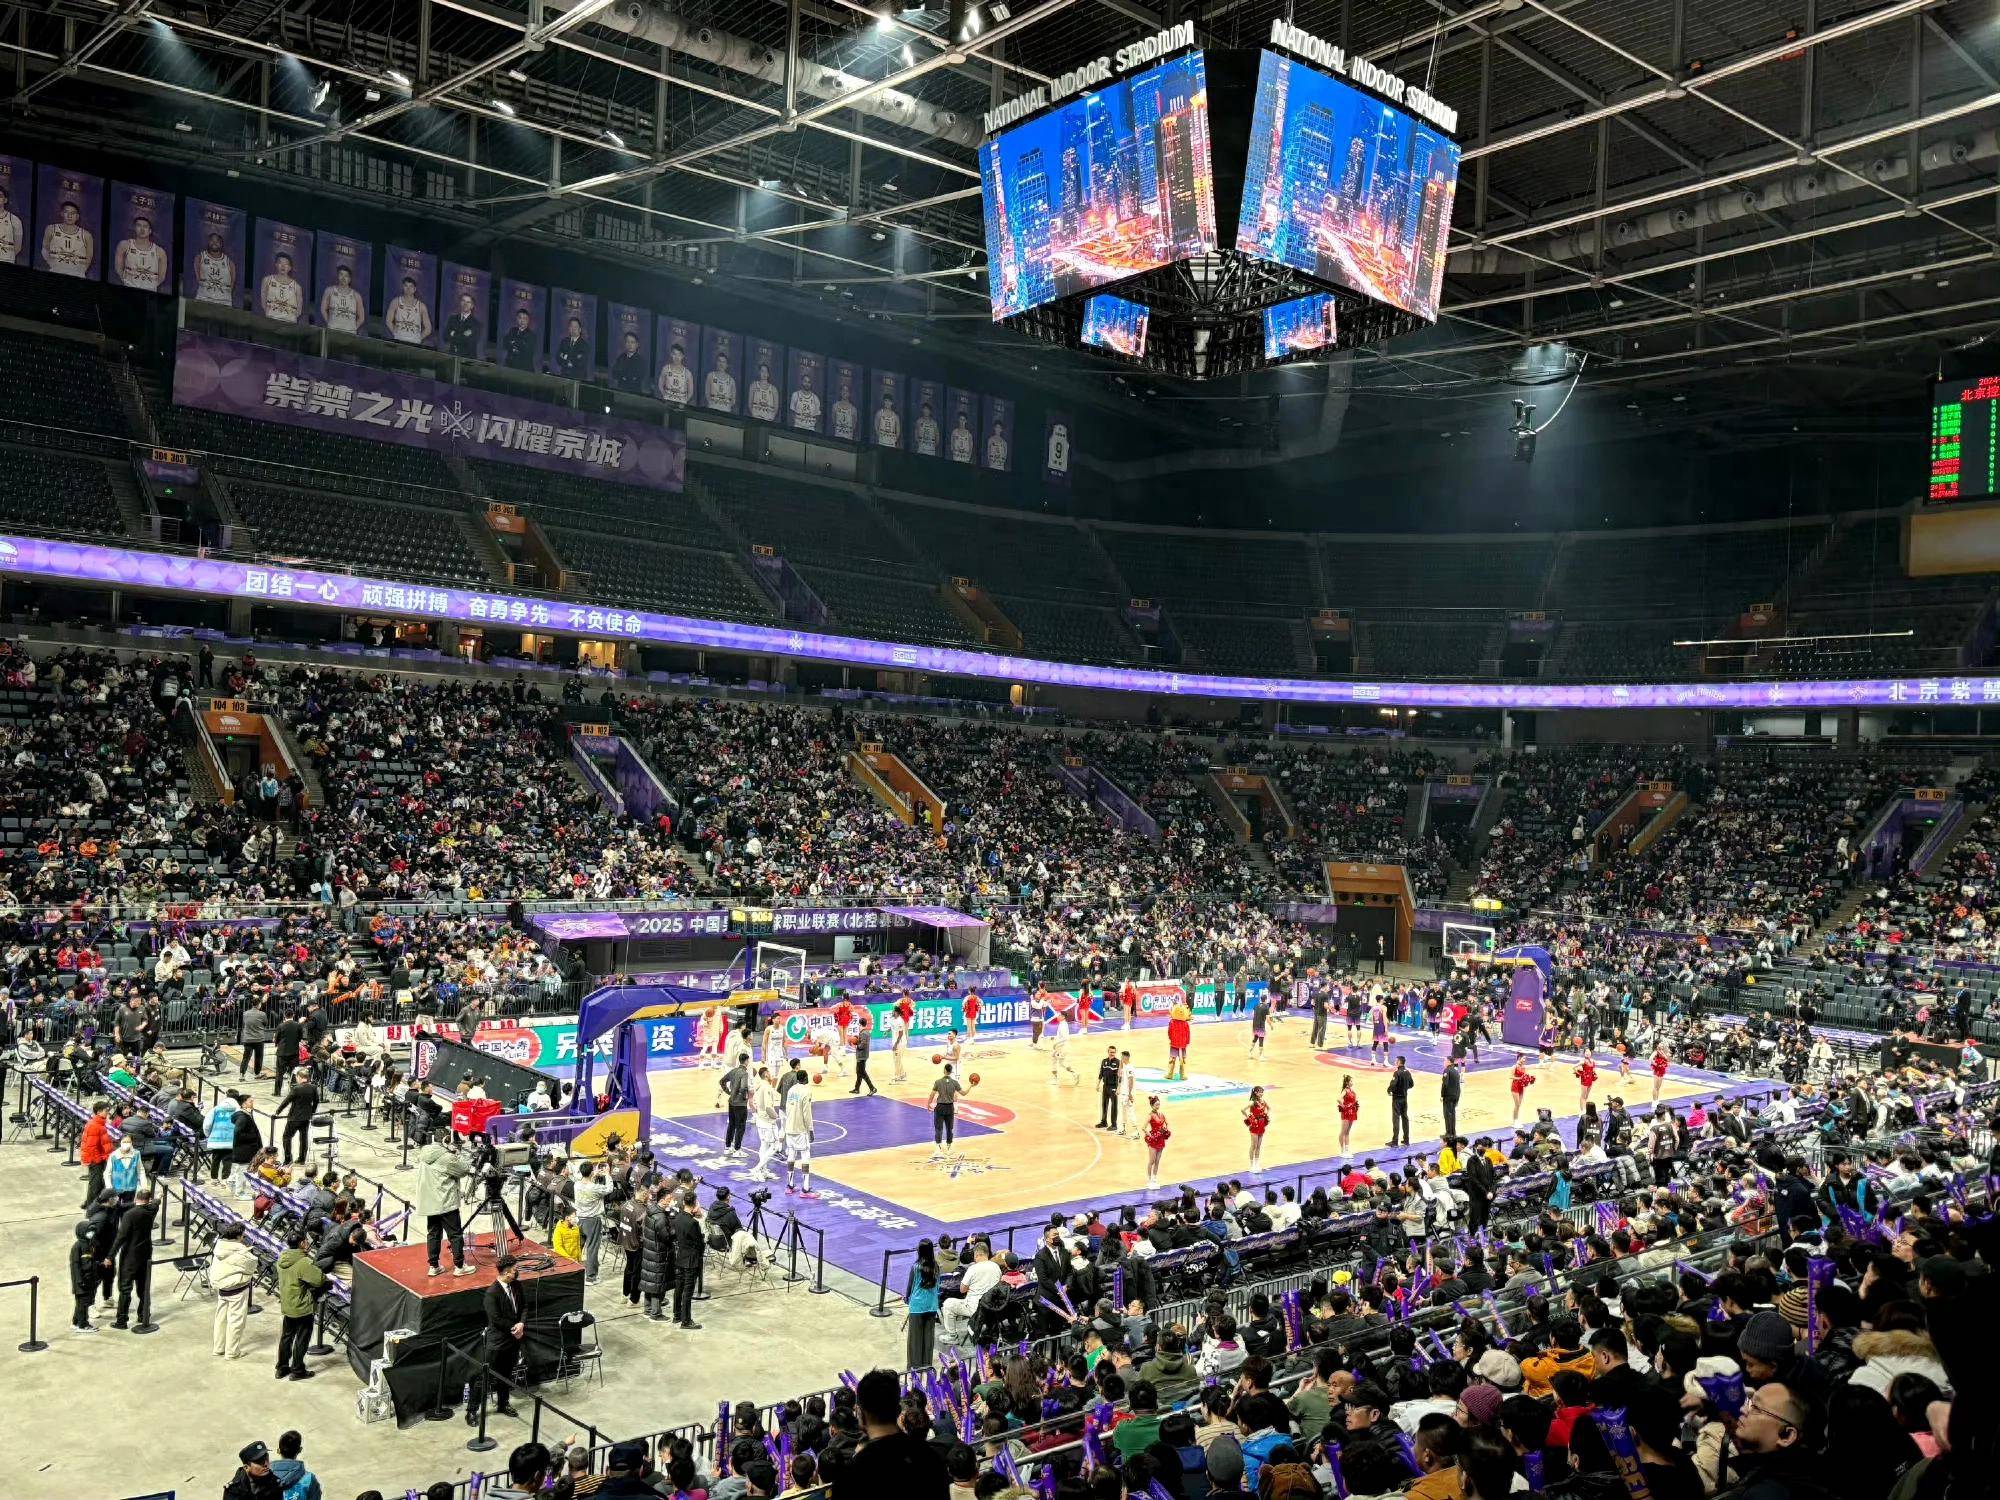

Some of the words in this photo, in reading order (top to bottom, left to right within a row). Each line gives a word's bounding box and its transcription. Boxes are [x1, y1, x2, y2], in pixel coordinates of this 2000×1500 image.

[983, 86, 1049, 134] NATIONAL
[1050, 56, 1112, 101] INDOOR
[1115, 20, 1195, 72] STADIUM
[1270, 18, 1347, 75] NATIONAL
[1352, 56, 1405, 103] INDOOR
[1405, 86, 1458, 133] STADIUM
[264, 372, 434, 434] 紫禁之光
[476, 412, 623, 468] 闪耀京城
[1055, 442, 1063, 459] 9
[246, 571, 339, 600] 团结一心
[362, 584, 449, 613] 顽强拼搏
[470, 597, 549, 624] 奋勇争先
[567, 609, 641, 634] 不负使命
[213, 700, 227, 710] 104
[232, 702, 244, 711] 103
[623, 917, 683, 935] -2025
[478, 1040, 528, 1051] 中国人寿
